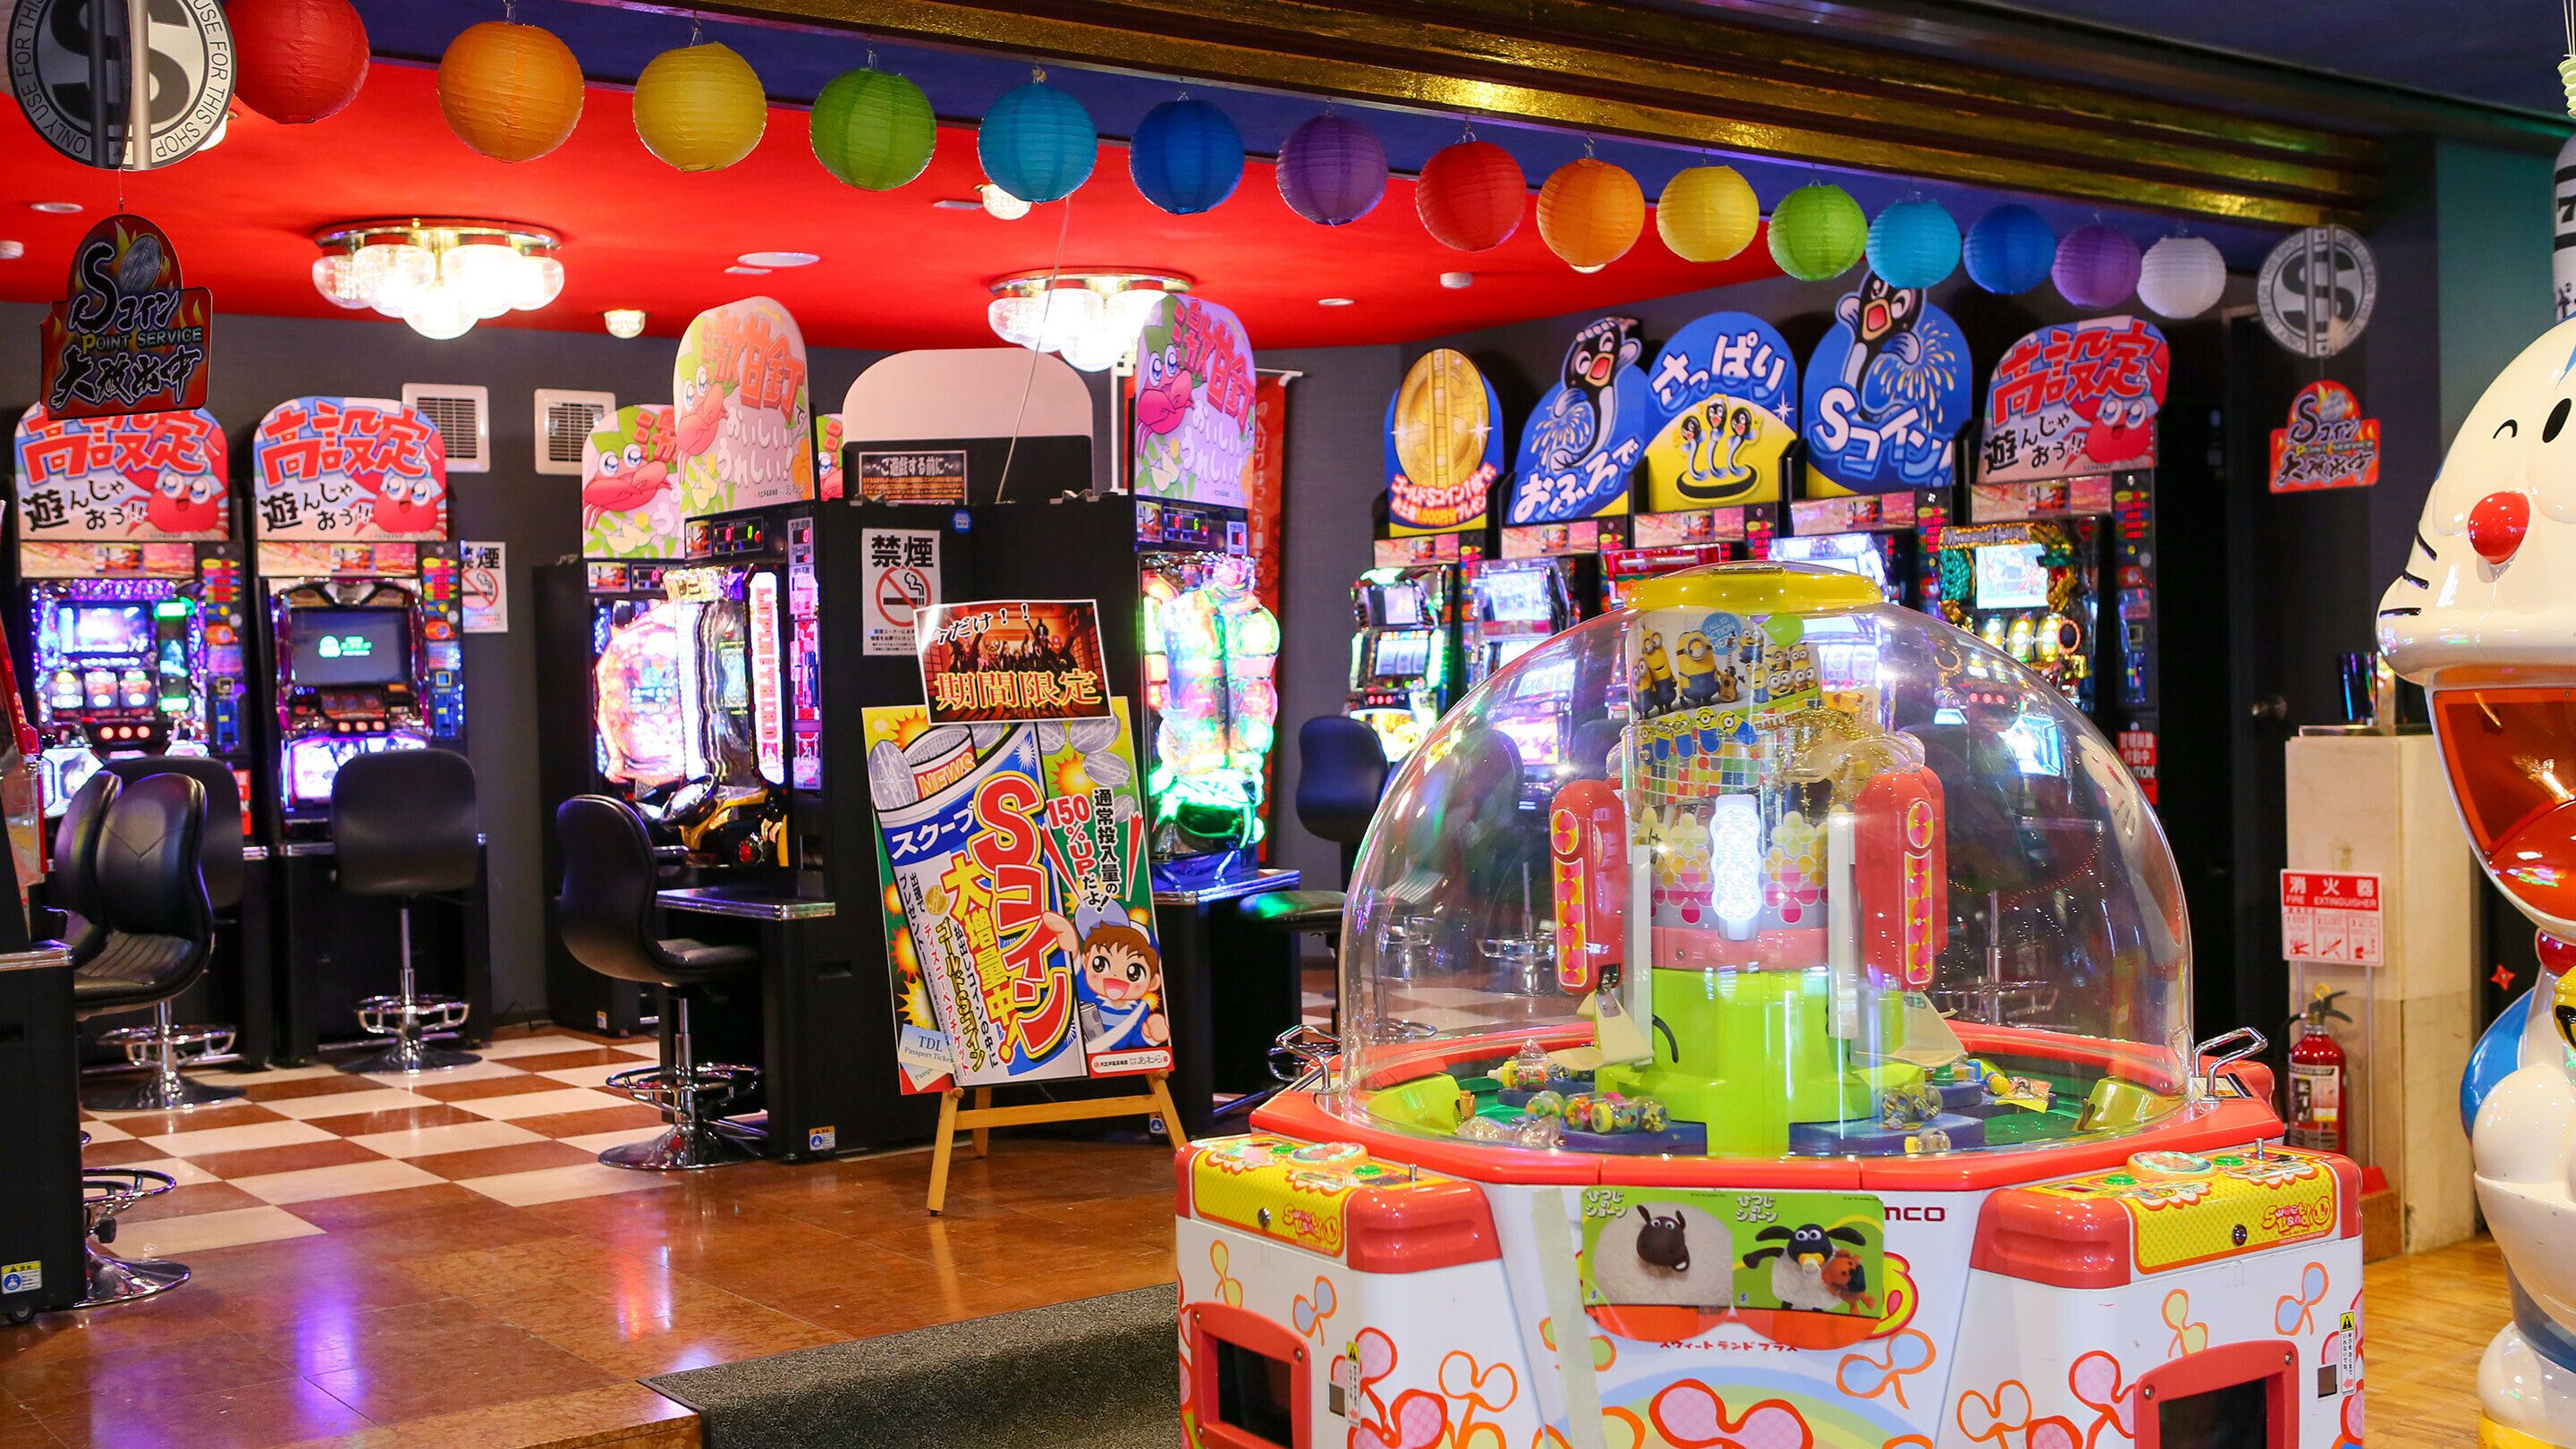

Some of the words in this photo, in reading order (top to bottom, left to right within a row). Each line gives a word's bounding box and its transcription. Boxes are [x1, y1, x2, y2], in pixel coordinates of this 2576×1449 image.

[15, 37, 32, 78] FOR
[210, 41, 228, 81] FOR
[21, 81, 48, 120] USE
[197, 86, 226, 125] THIS
[44, 117, 87, 154] ONLY
[155, 122, 200, 157] SHOP
[81, 334, 131, 354] POINT
[136, 327, 203, 347] SERVICE
[1652, 331, 1785, 411] さっぱり
[1993, 319, 2158, 428] 高設定
[22, 409, 212, 487] 高設定
[258, 400, 432, 488] 高設定
[1813, 386, 1953, 487] Sコイン!
[1984, 413, 2071, 475] 遊んじゃ
[1513, 436, 1640, 524] おふろで
[22, 480, 125, 532] 遊んじゃ
[260, 483, 353, 532] 遊んじゃ
[871, 535, 935, 568] 禁煙
[934, 668, 1103, 711] 期間限定
[918, 752, 977, 799] NEWS
[891, 801, 975, 860] スクープ
[1093, 789, 1121, 894] 通常投入量の
[2289, 876, 2374, 897] 消火器
[970, 775, 1072, 1055] Sコイン
[919, 1036, 943, 1052] TDL
[1586, 1190, 1624, 1203] ひつじ
[1601, 1200, 1611, 1208] の
[1737, 1195, 1775, 1208] ひつじ
[1751, 1206, 1762, 1214] の
[1717, 1341, 1754, 1351] ランド
